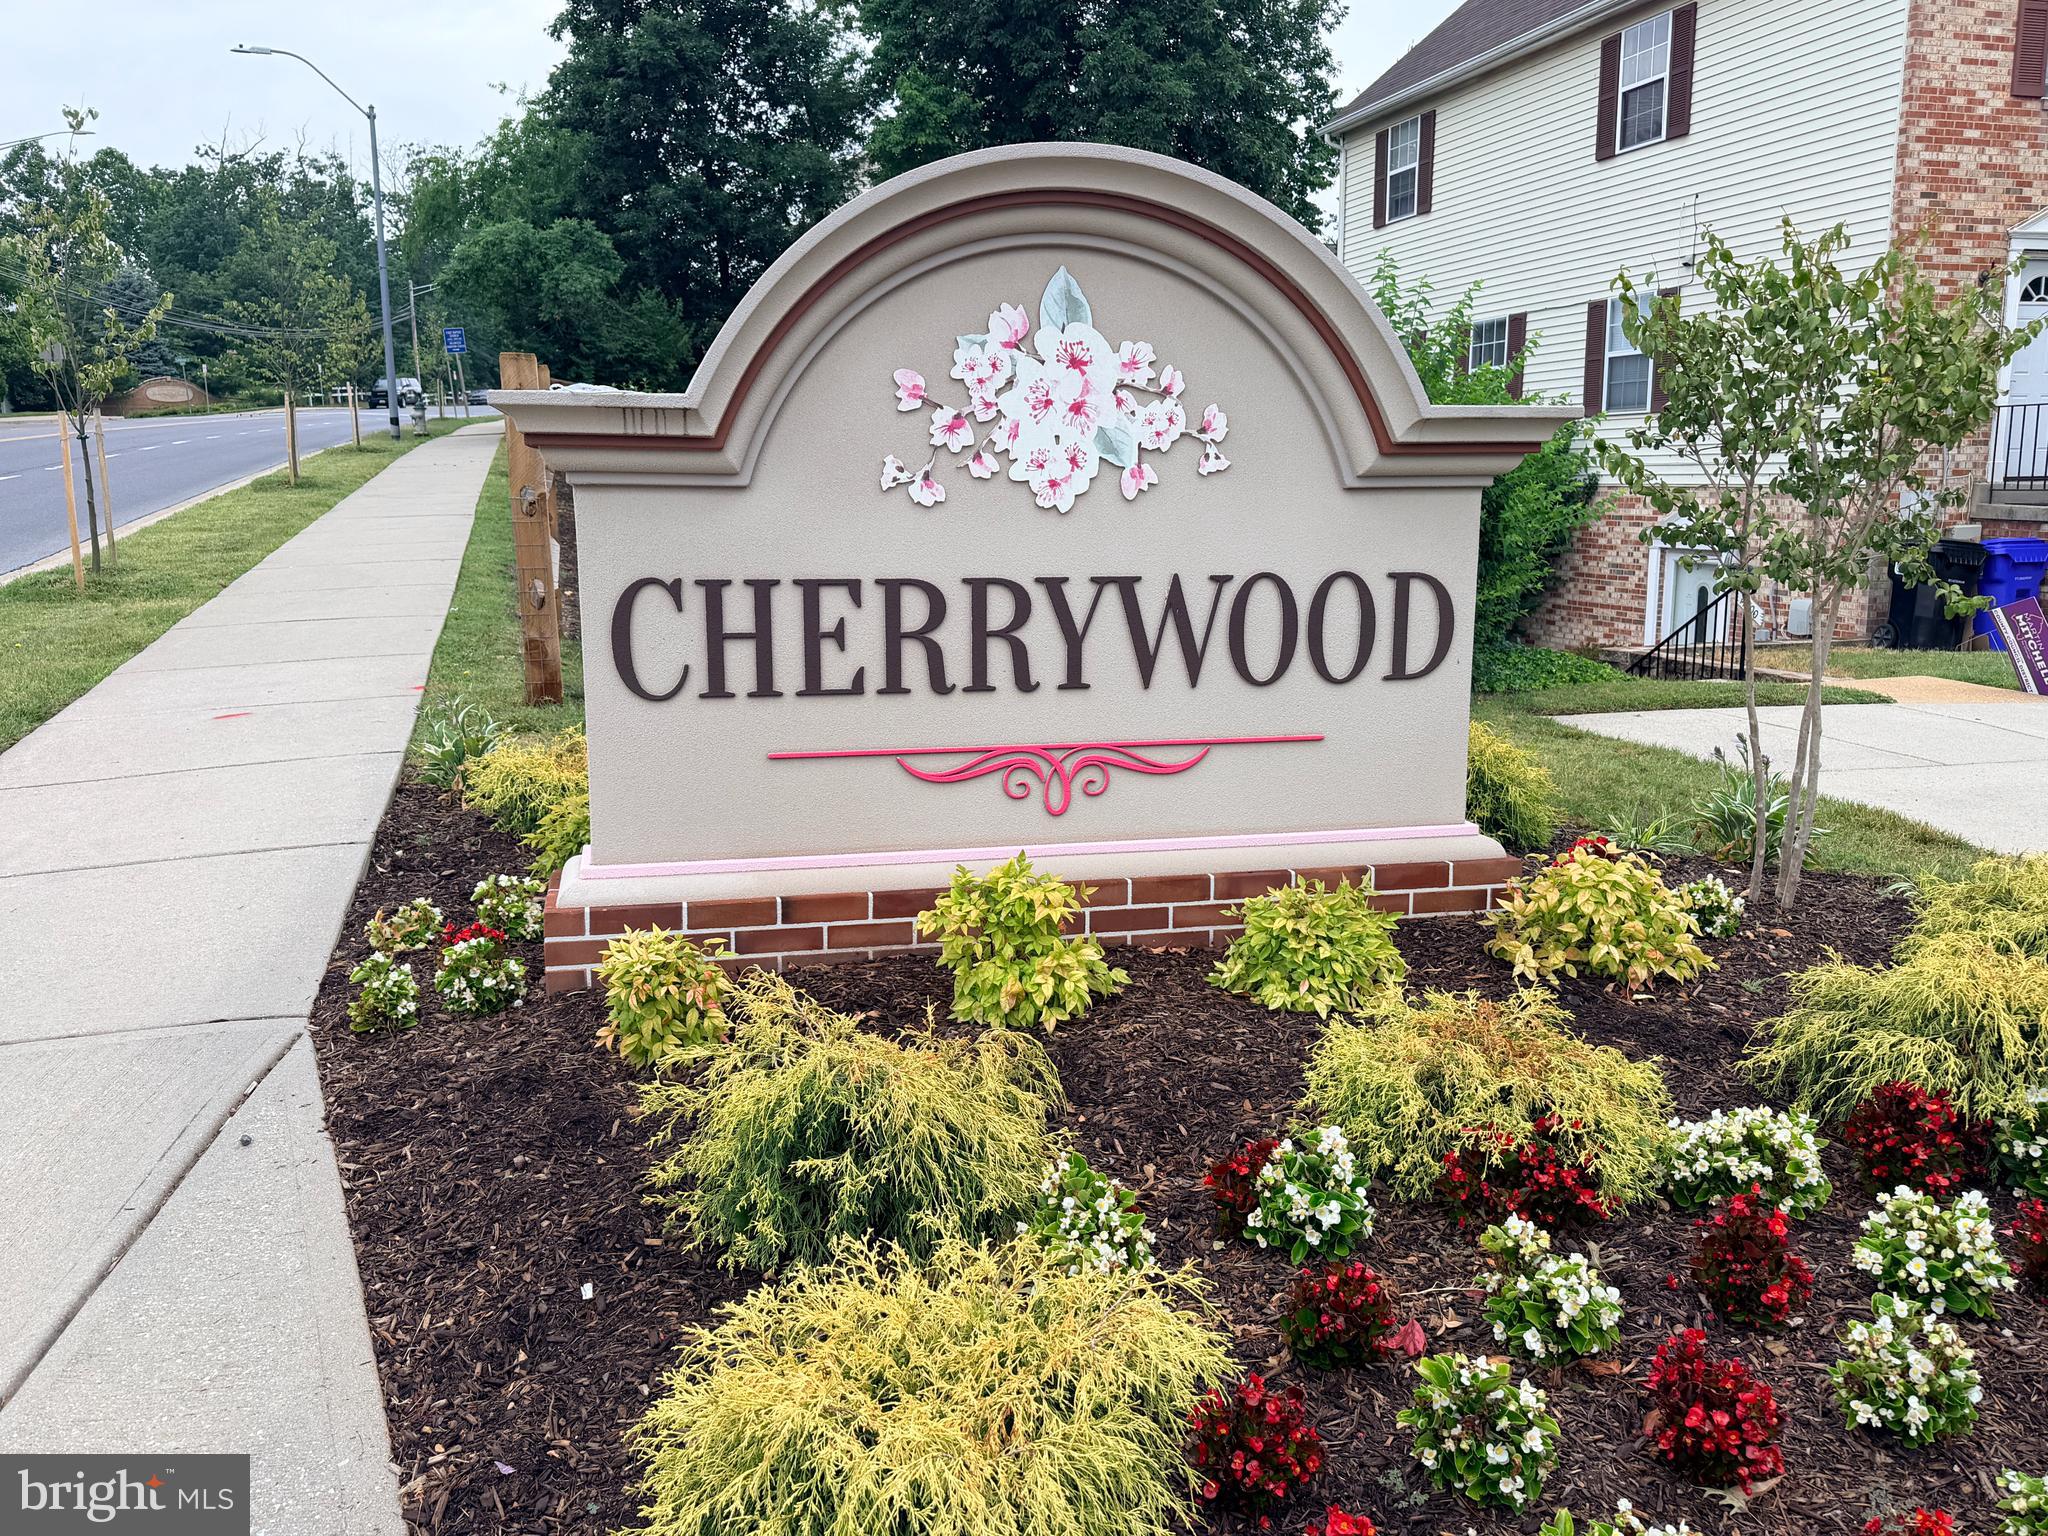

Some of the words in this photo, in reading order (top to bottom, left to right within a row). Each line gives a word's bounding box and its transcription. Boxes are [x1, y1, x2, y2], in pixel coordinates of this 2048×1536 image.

[611, 570, 1455, 701] CHERRYWOOD
[1994, 609, 2008, 635] COUNTY
[2007, 635, 2023, 665] COUNCIL
[2019, 664, 2034, 694] DISTRICT
[2024, 612, 2045, 651] MARTIN
